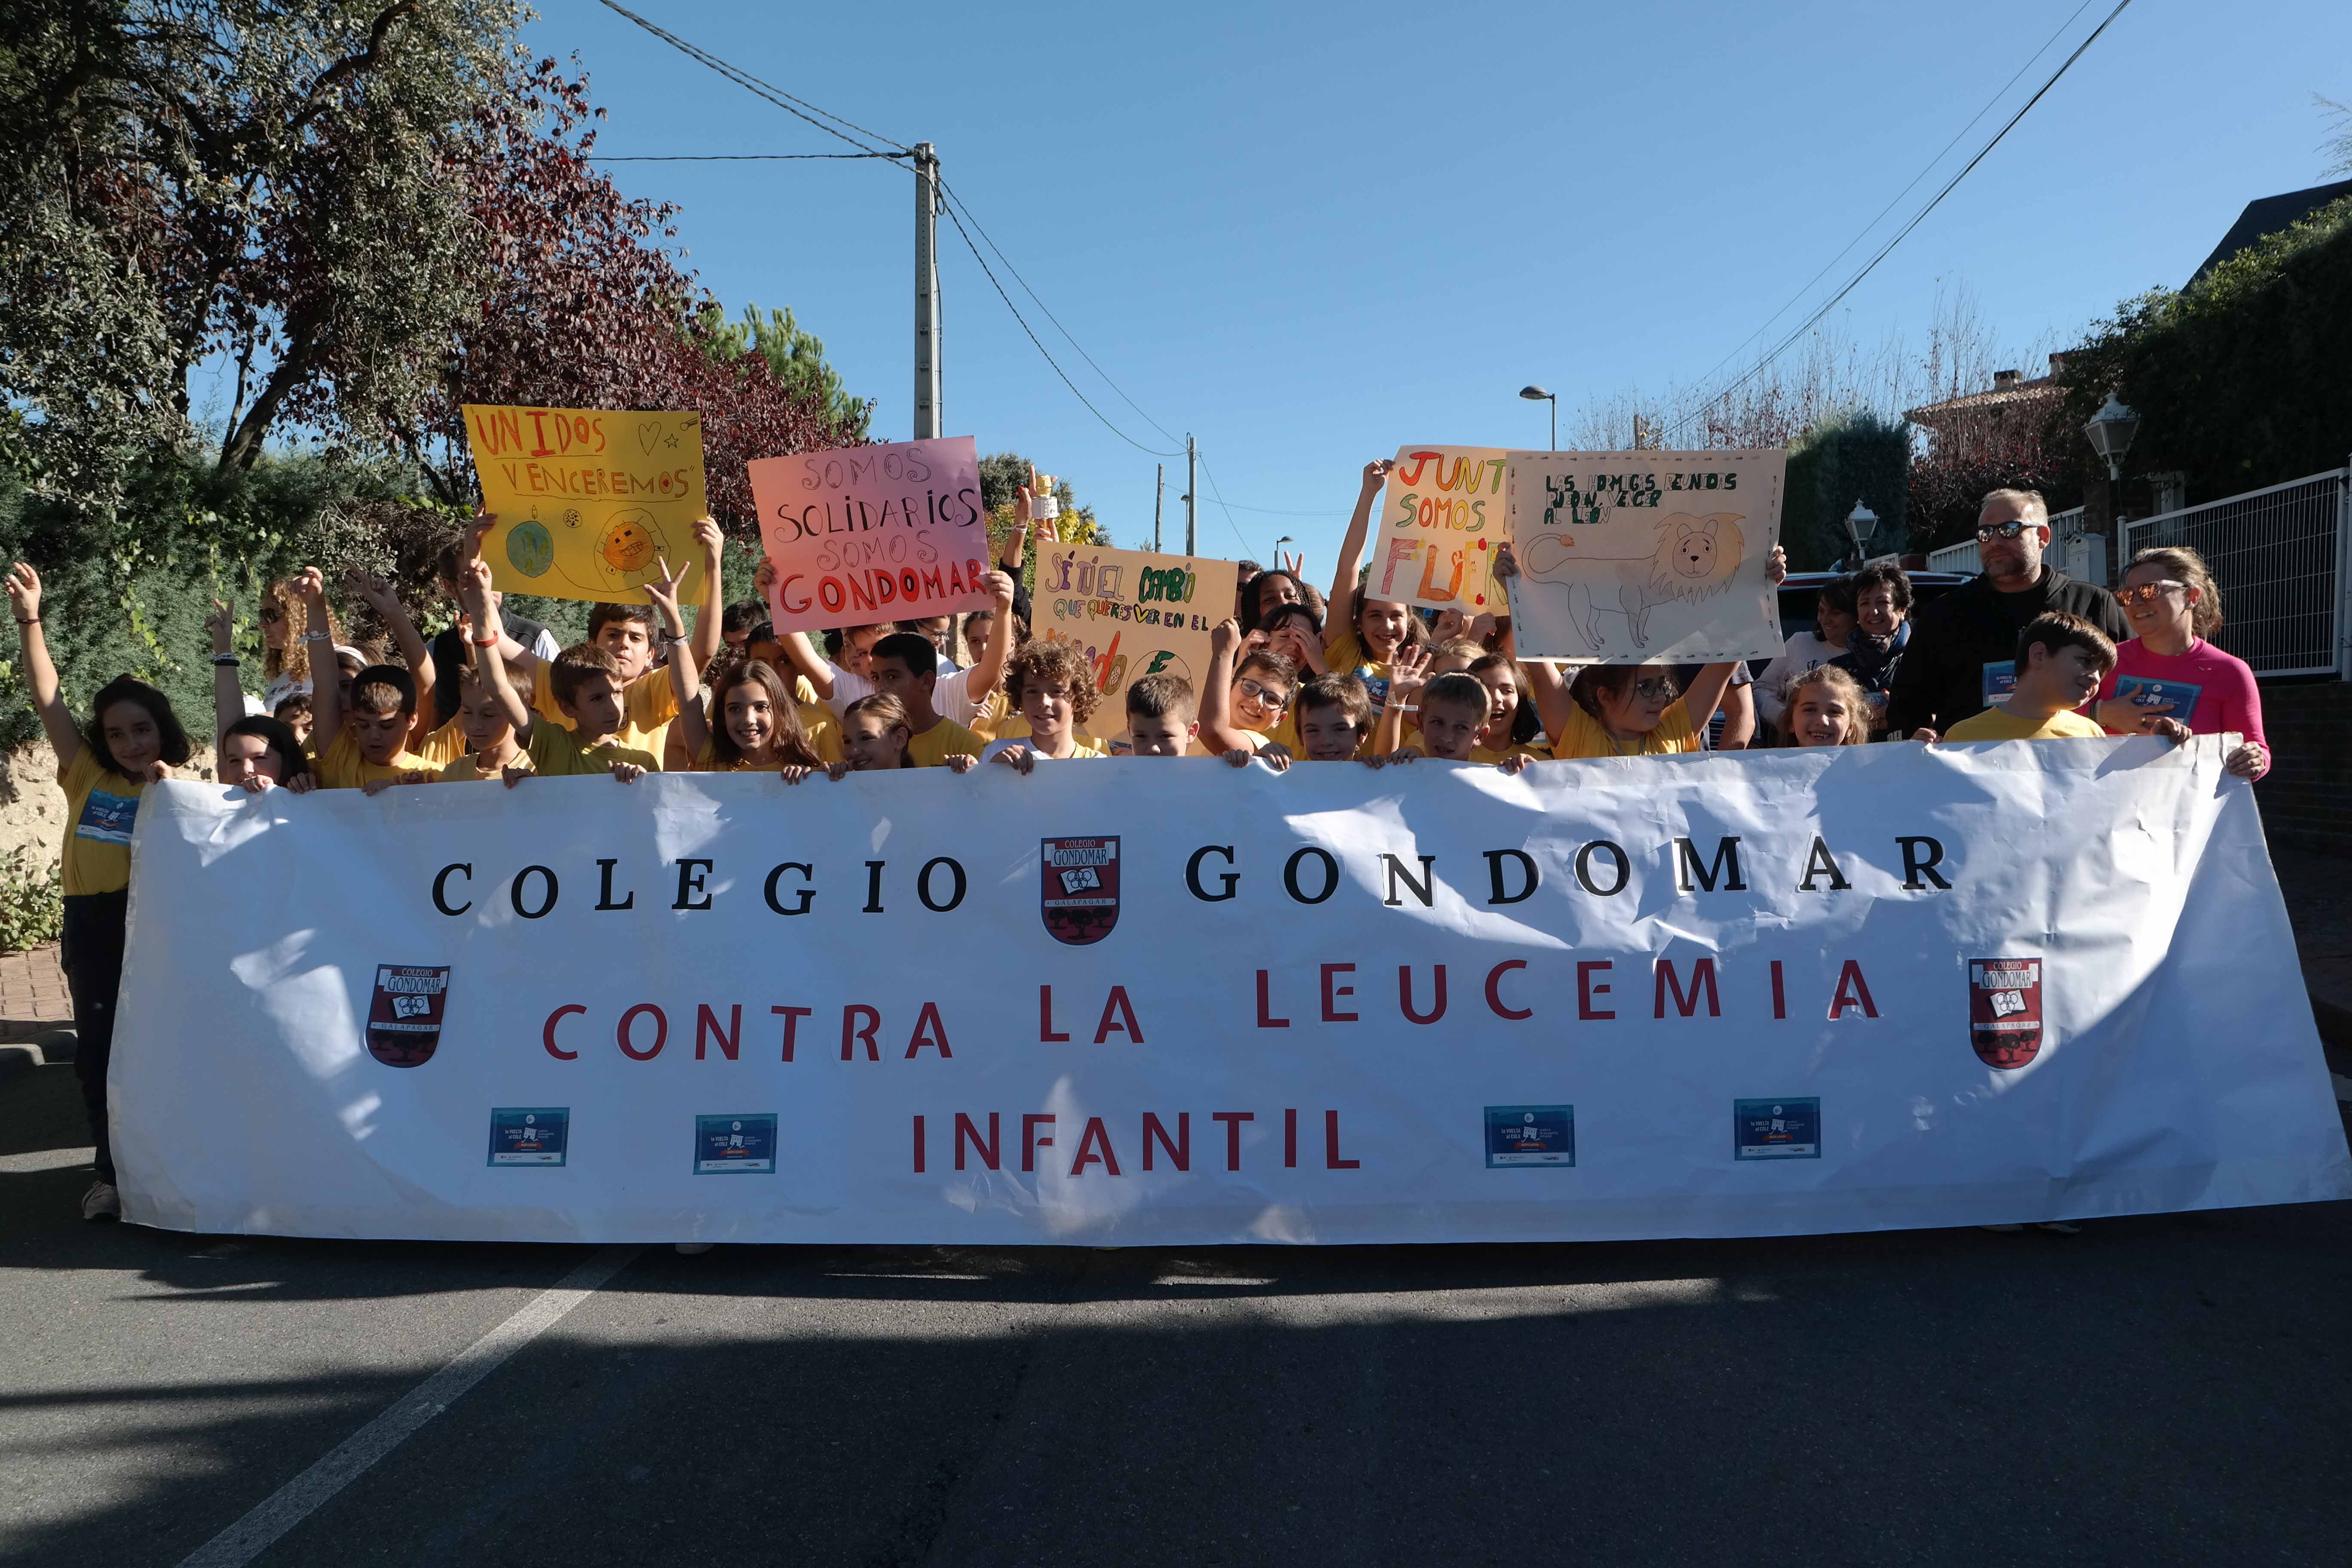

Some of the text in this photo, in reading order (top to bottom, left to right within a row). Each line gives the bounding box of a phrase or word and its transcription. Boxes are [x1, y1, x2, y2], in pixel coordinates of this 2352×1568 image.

[802, 447, 931, 490] SOMOS
[1546, 473, 1737, 492] LAS HORMIGAS REUNIDAS
[1396, 493, 1485, 532] SOMOS
[1547, 490, 1662, 508] PUEDEN VENCER
[1544, 502, 1611, 524] AL LEÓN
[817, 530, 938, 571] SOMOS
[780, 559, 987, 614] GONDOMAR
[1045, 551, 1075, 592] SÉ
[1076, 556, 1099, 596] TÚ
[1096, 565, 1125, 602] EL
[1053, 598, 1086, 621] QUE
[1133, 603, 1160, 625] VER
[1164, 612, 1185, 628] EN
[1191, 614, 1209, 631] EL
[1065, 839, 1096, 848] COLEGIO
[1054, 849, 1107, 866] GONDOMAR
[432, 835, 1952, 919] COLEGIO GONDOMAR
[402, 968, 433, 977] COLEGIO
[1982, 971, 2031, 988] GONDOMAR
[1993, 962, 2021, 970] COLEGIO
[388, 977, 441, 993] GONDOMAR
[542, 958, 1880, 1063] CONTRA LA LEUCEMIA
[913, 1109, 1360, 1176] INFANTIL
